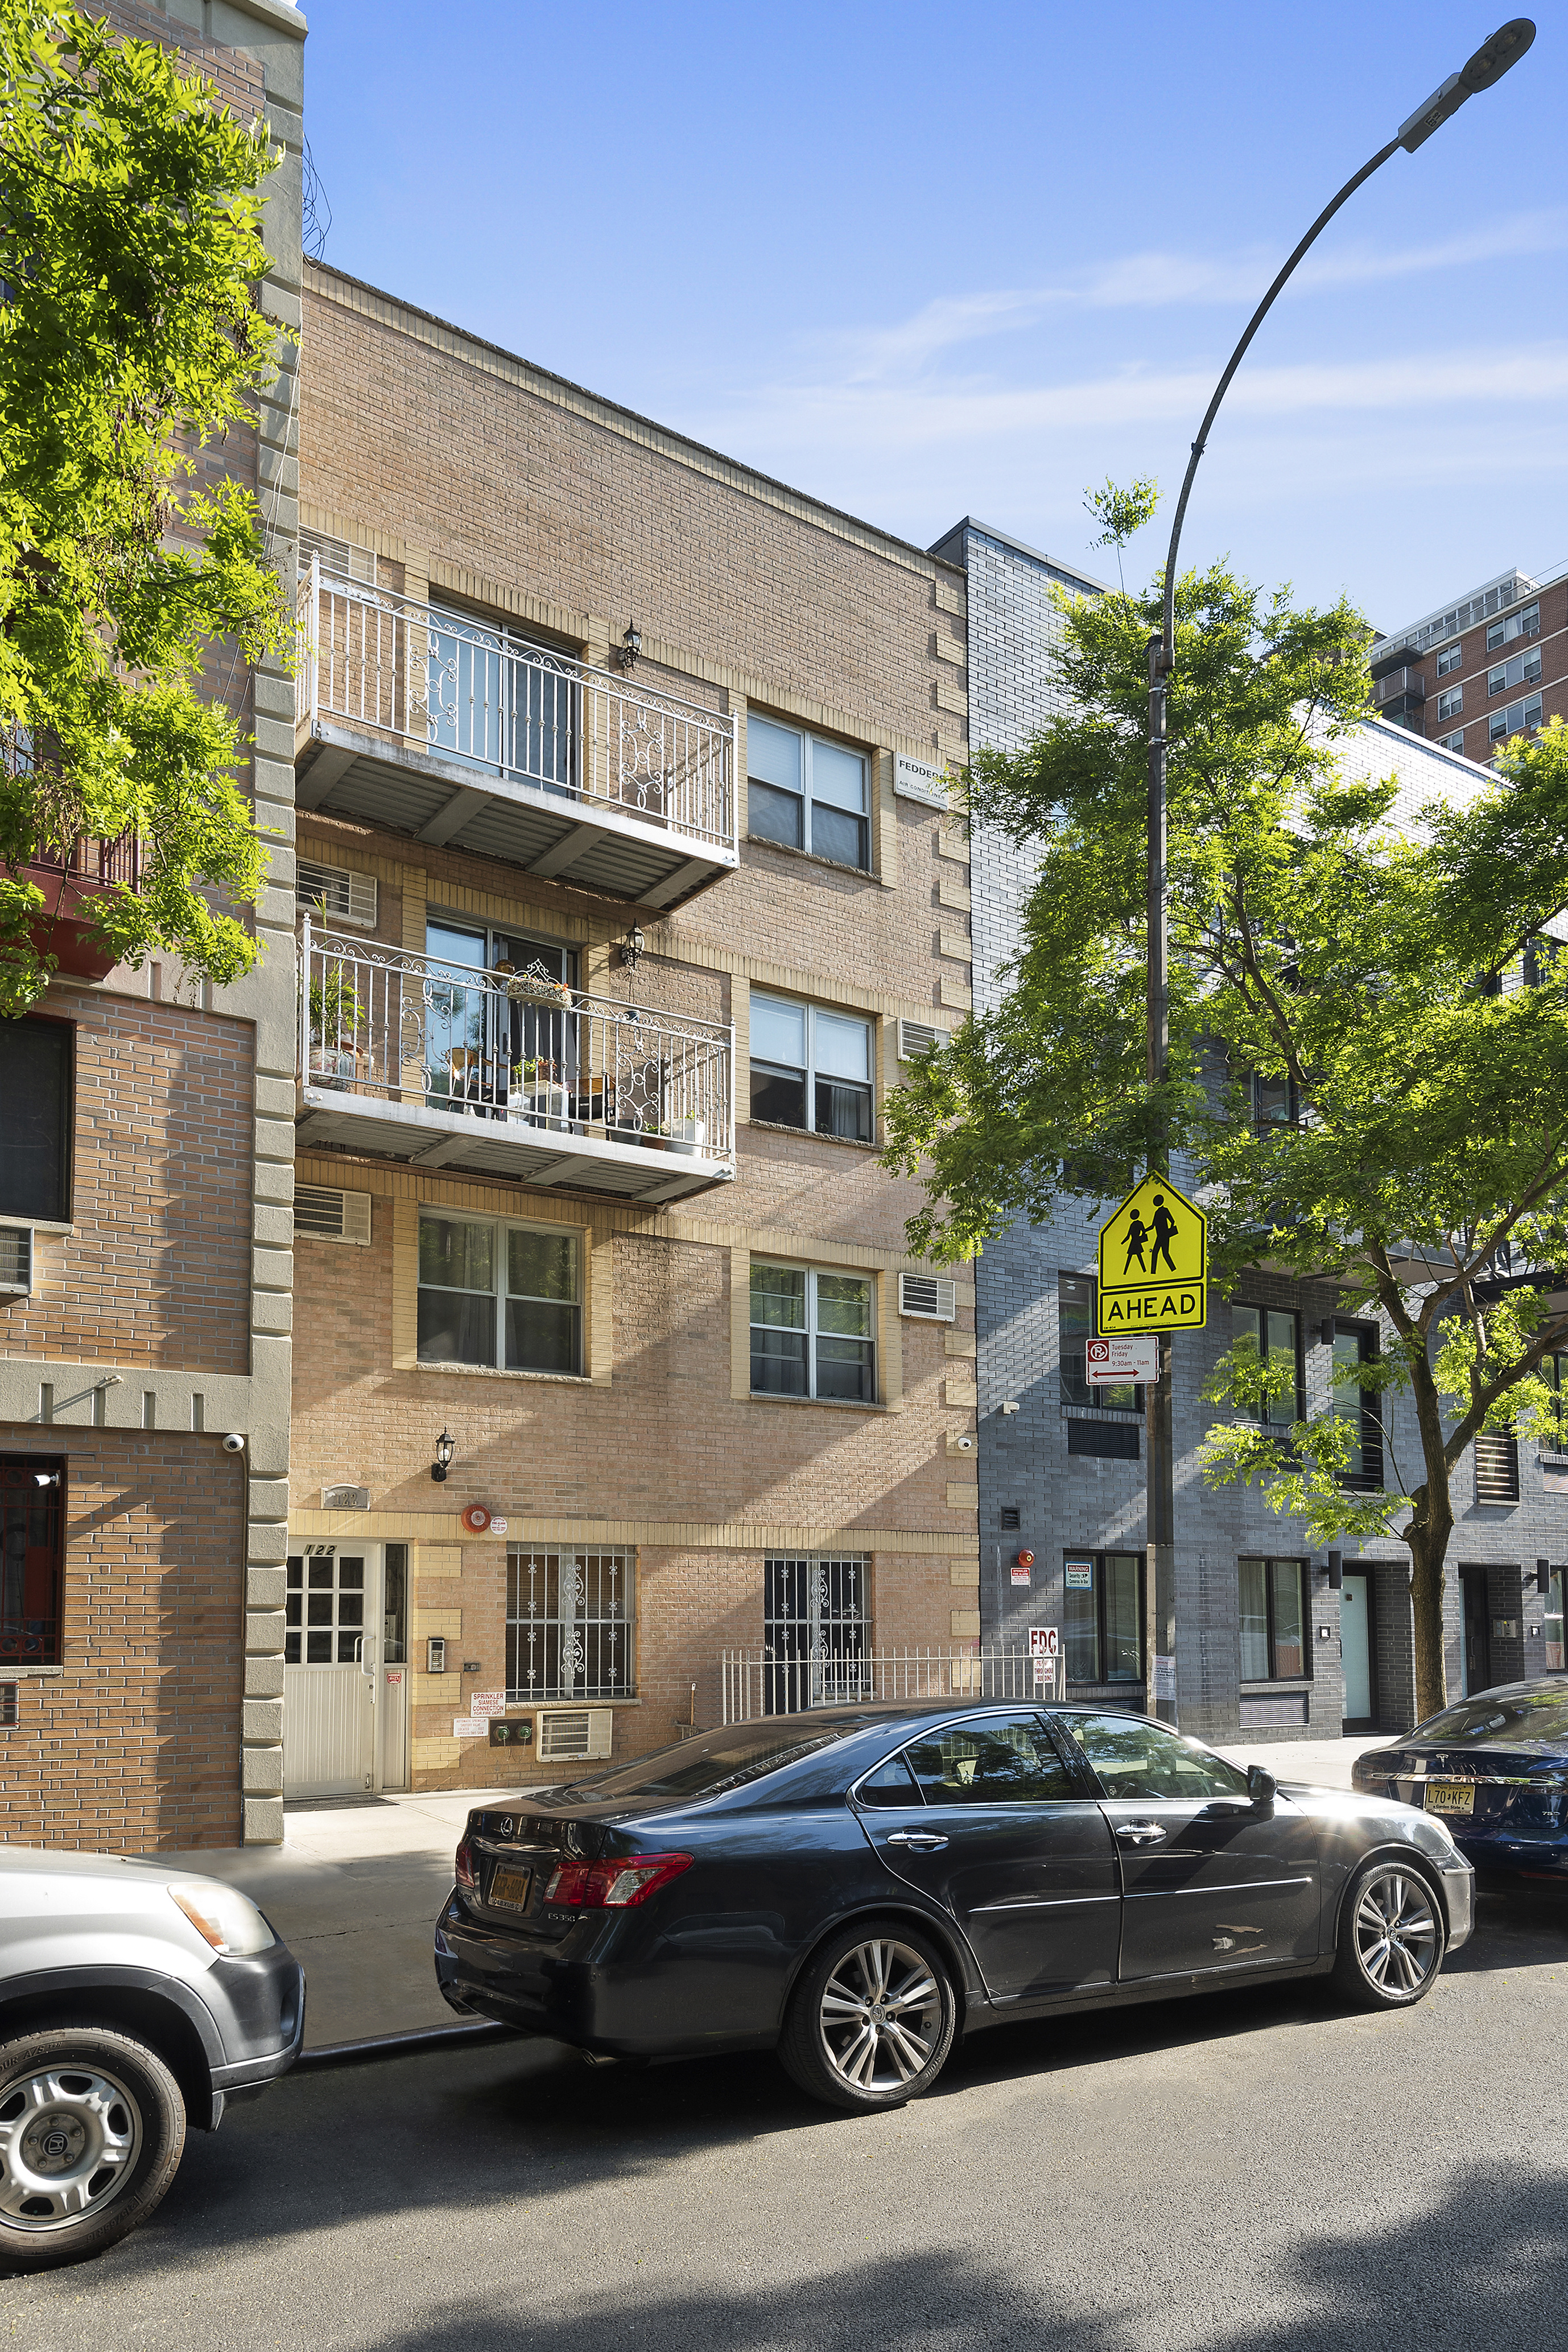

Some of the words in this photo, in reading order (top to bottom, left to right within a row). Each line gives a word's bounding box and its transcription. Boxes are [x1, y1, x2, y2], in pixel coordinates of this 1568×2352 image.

[1108, 1294, 1195, 1321] AHEAD
[334, 1492, 357, 1507] 122
[306, 1545, 336, 1555] 122
[1031, 1630, 1057, 1654] FDC
[23, 2044, 45, 2060] A/S
[86, 2201, 137, 2243] 215/65R16
